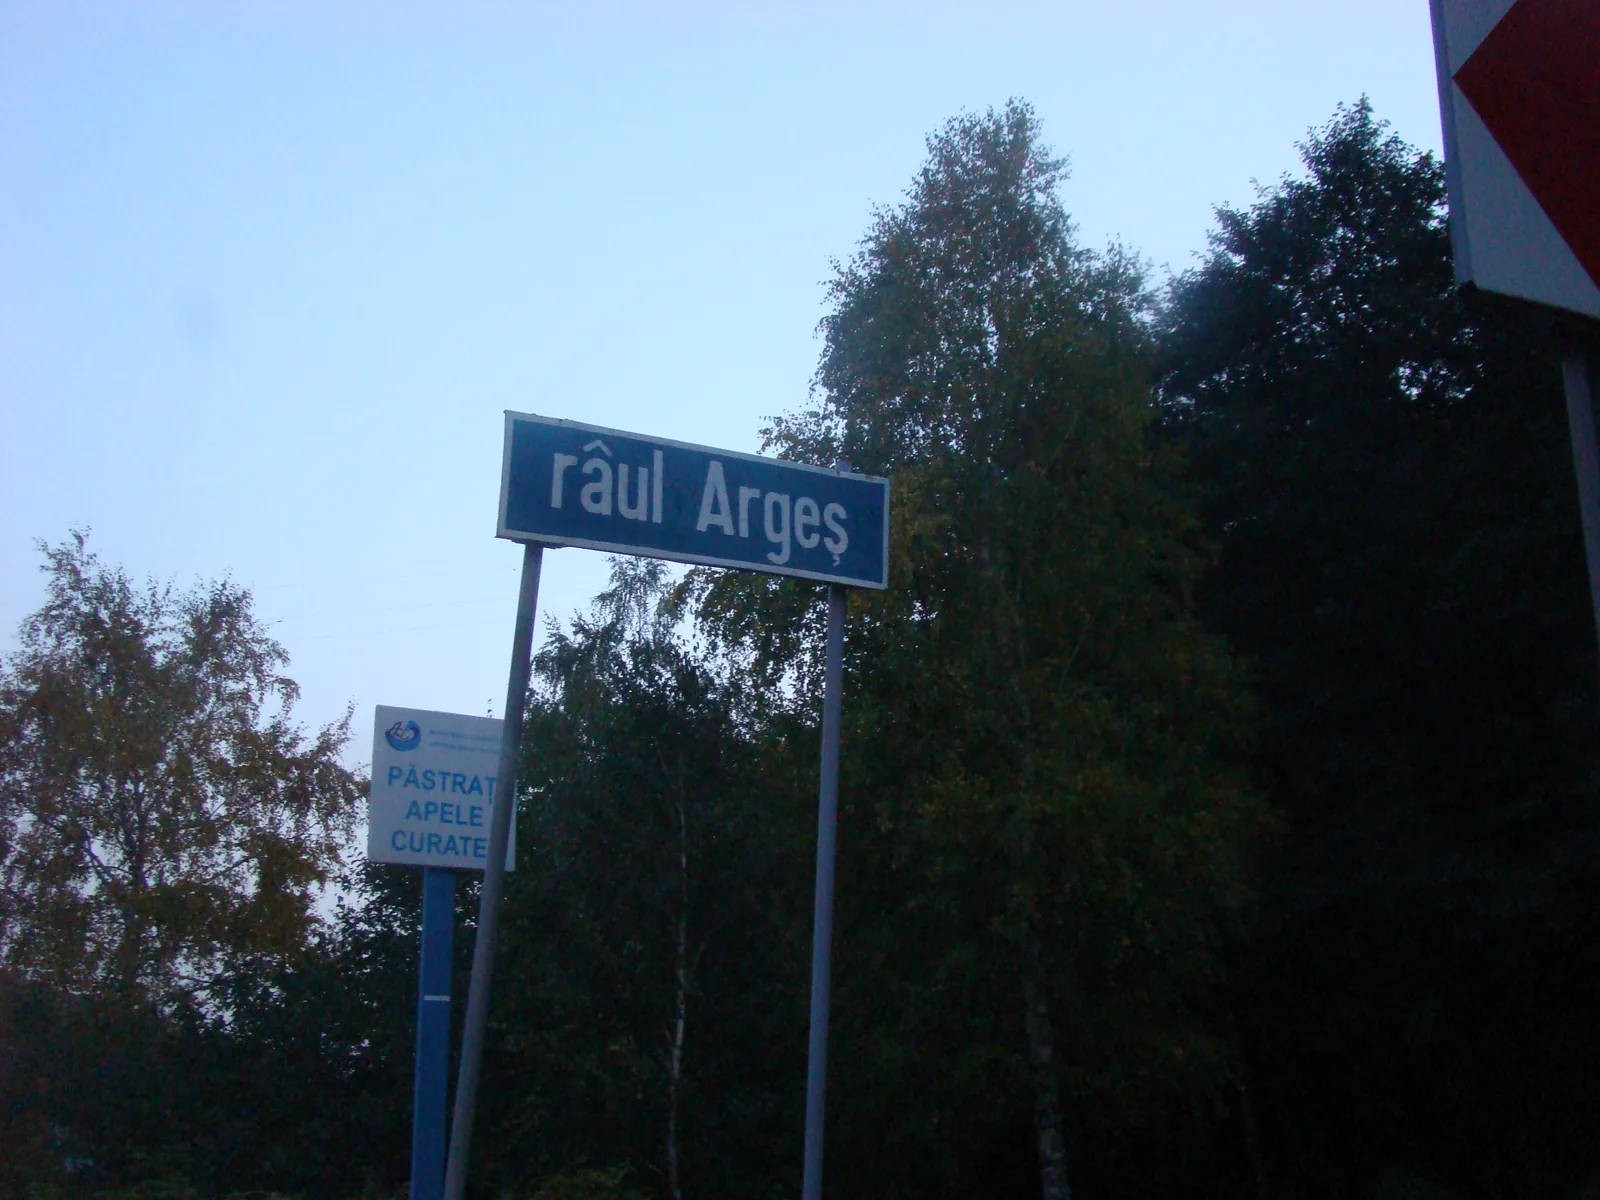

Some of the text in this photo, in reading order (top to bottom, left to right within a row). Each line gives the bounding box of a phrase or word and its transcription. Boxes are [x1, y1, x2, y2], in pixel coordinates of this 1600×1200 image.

[551, 440, 849, 567] râul Argeș
[387, 763, 498, 805] PĂSTRAȚ
[405, 800, 484, 828] APELE
[391, 830, 488, 859] CURATE
